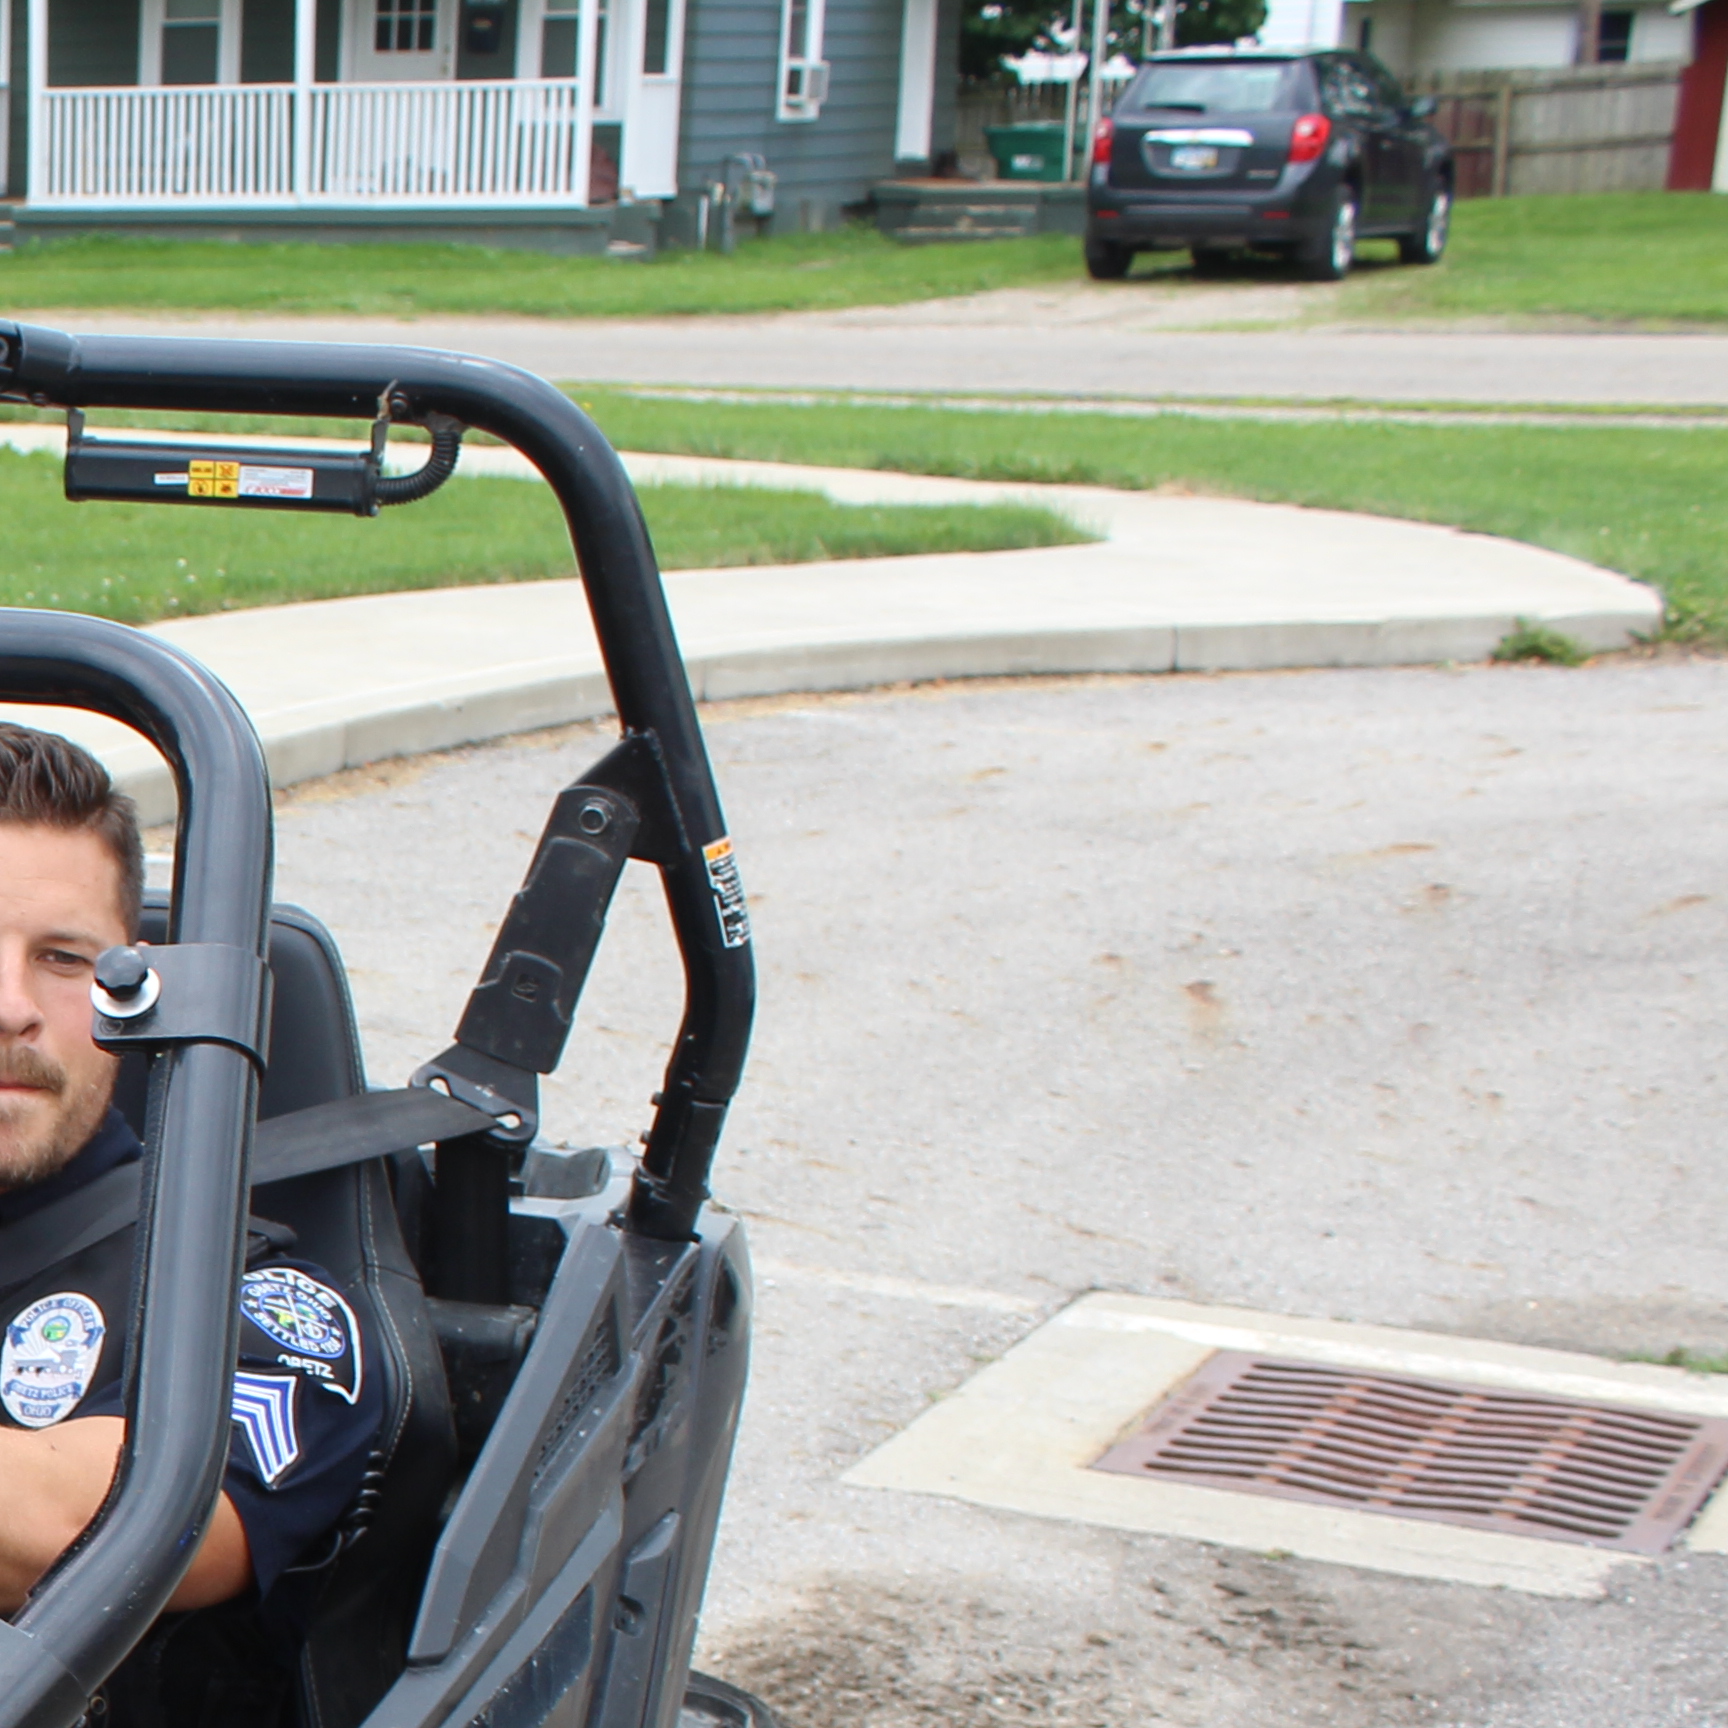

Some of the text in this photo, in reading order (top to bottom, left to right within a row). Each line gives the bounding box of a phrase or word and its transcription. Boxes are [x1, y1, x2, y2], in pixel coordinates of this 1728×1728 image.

[242, 1270, 338, 1309] OLICE
[295, 1290, 333, 1321] OHIO
[253, 1312, 321, 1352] SETTLED
